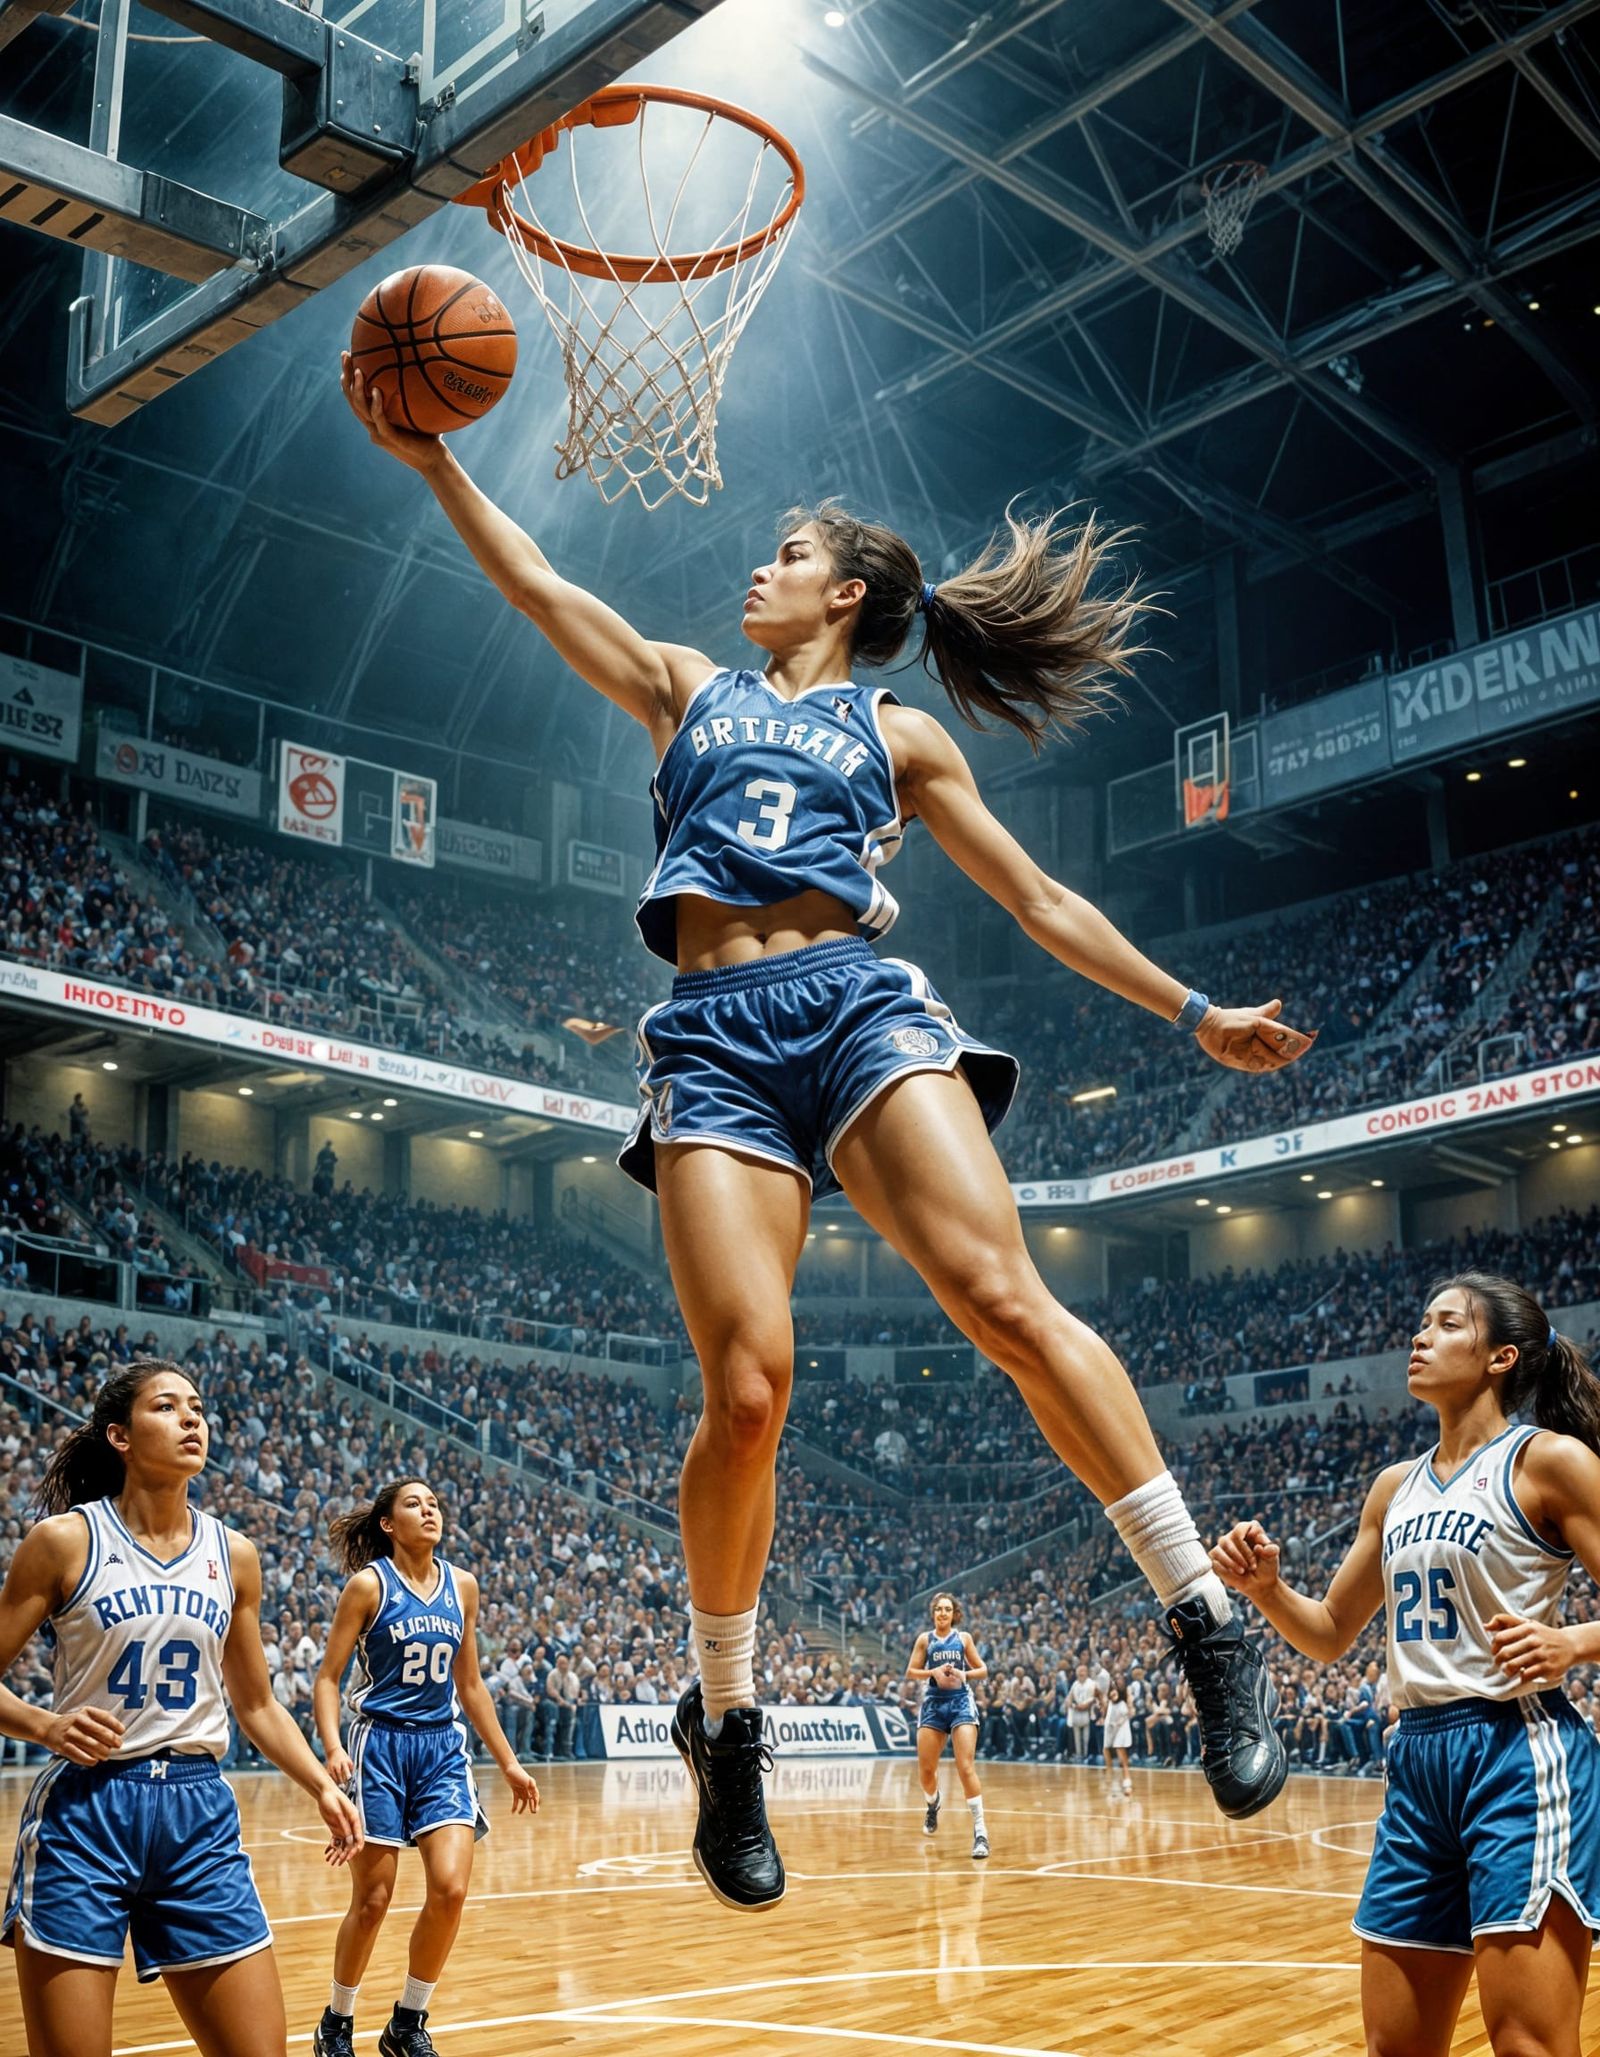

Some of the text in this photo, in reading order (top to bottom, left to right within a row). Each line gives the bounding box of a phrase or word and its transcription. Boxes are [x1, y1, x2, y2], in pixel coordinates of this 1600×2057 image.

[737, 779, 798, 852] 3
[1220, 1149, 1237, 1168] K
[1394, 1568, 1459, 1643] 25
[108, 1640, 200, 1711] 43
[402, 1641, 453, 1686] 20
